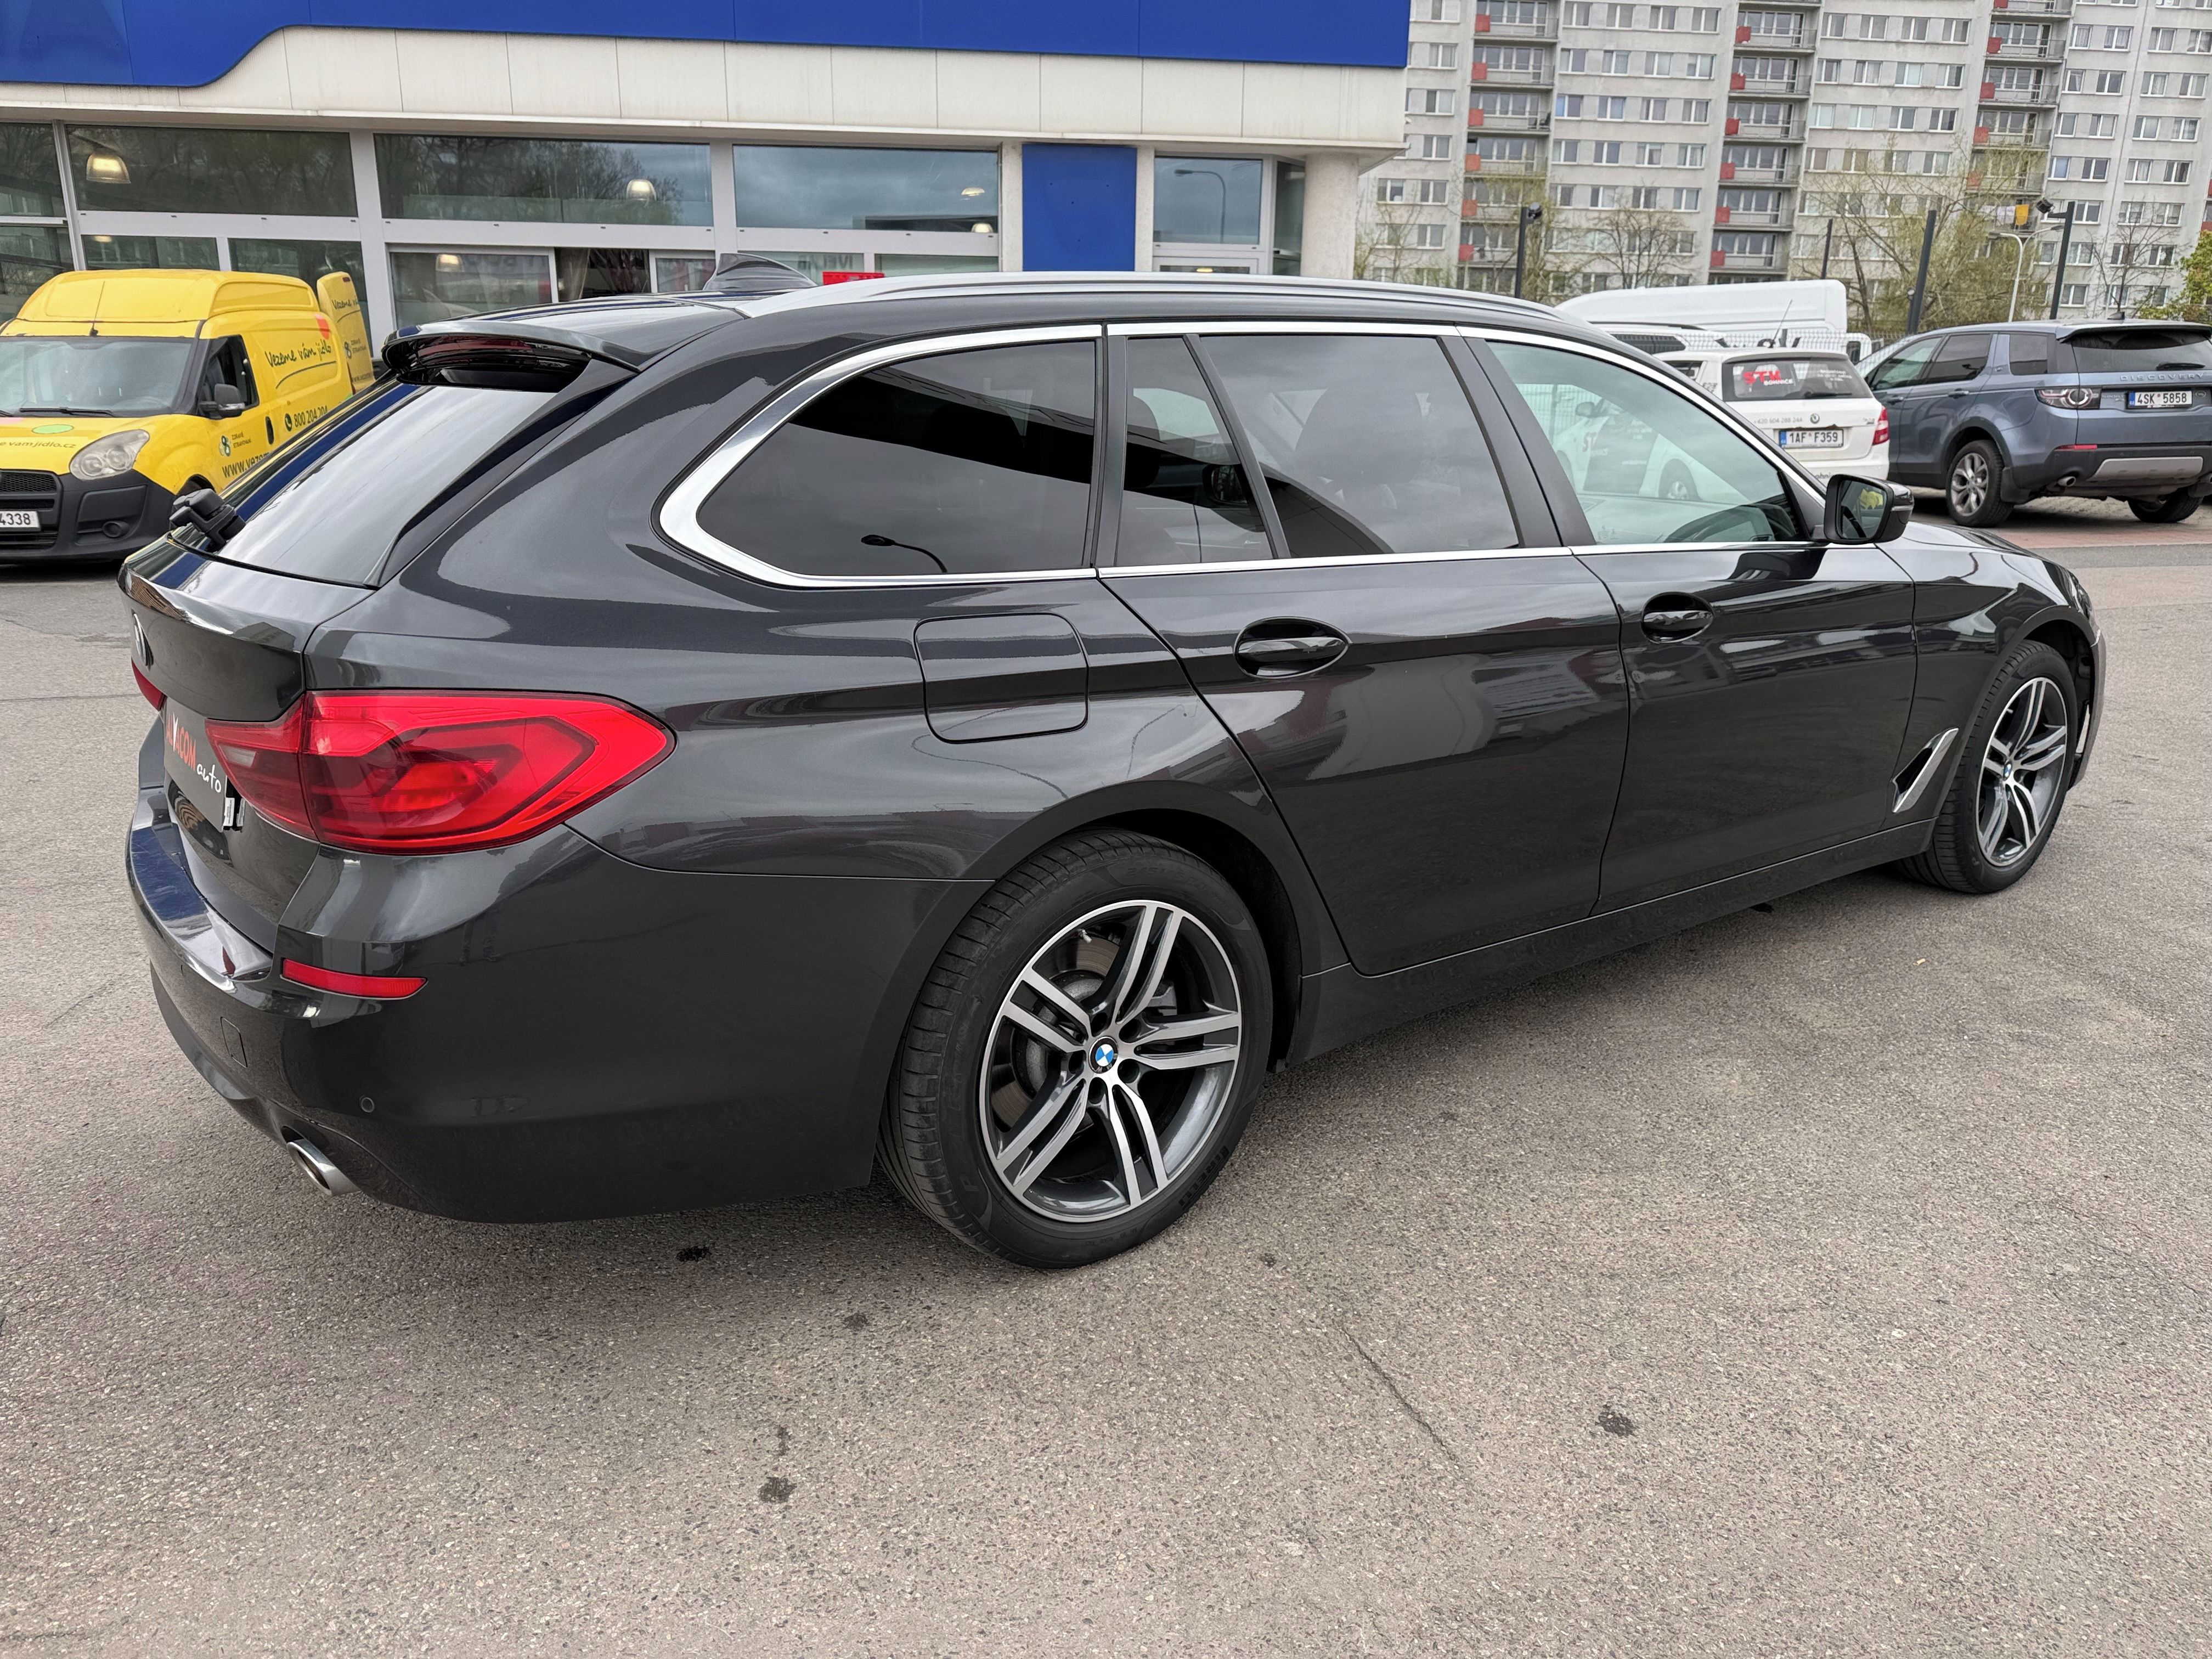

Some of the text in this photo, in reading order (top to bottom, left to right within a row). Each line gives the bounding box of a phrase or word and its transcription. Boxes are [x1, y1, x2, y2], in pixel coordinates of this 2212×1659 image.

[264, 349, 297, 368] Vezeme
[298, 342, 317, 360] vám
[2119, 373, 2204, 382] DISCOVERY
[2137, 393, 2155, 404] 4SK
[2163, 392, 2187, 404] 5858
[294, 411, 306, 427] 800
[306, 408, 318, 424] 204
[1789, 431, 1838, 443] 1AF F359
[0, 512, 31, 526] 4338
[196, 763, 222, 793] auto
